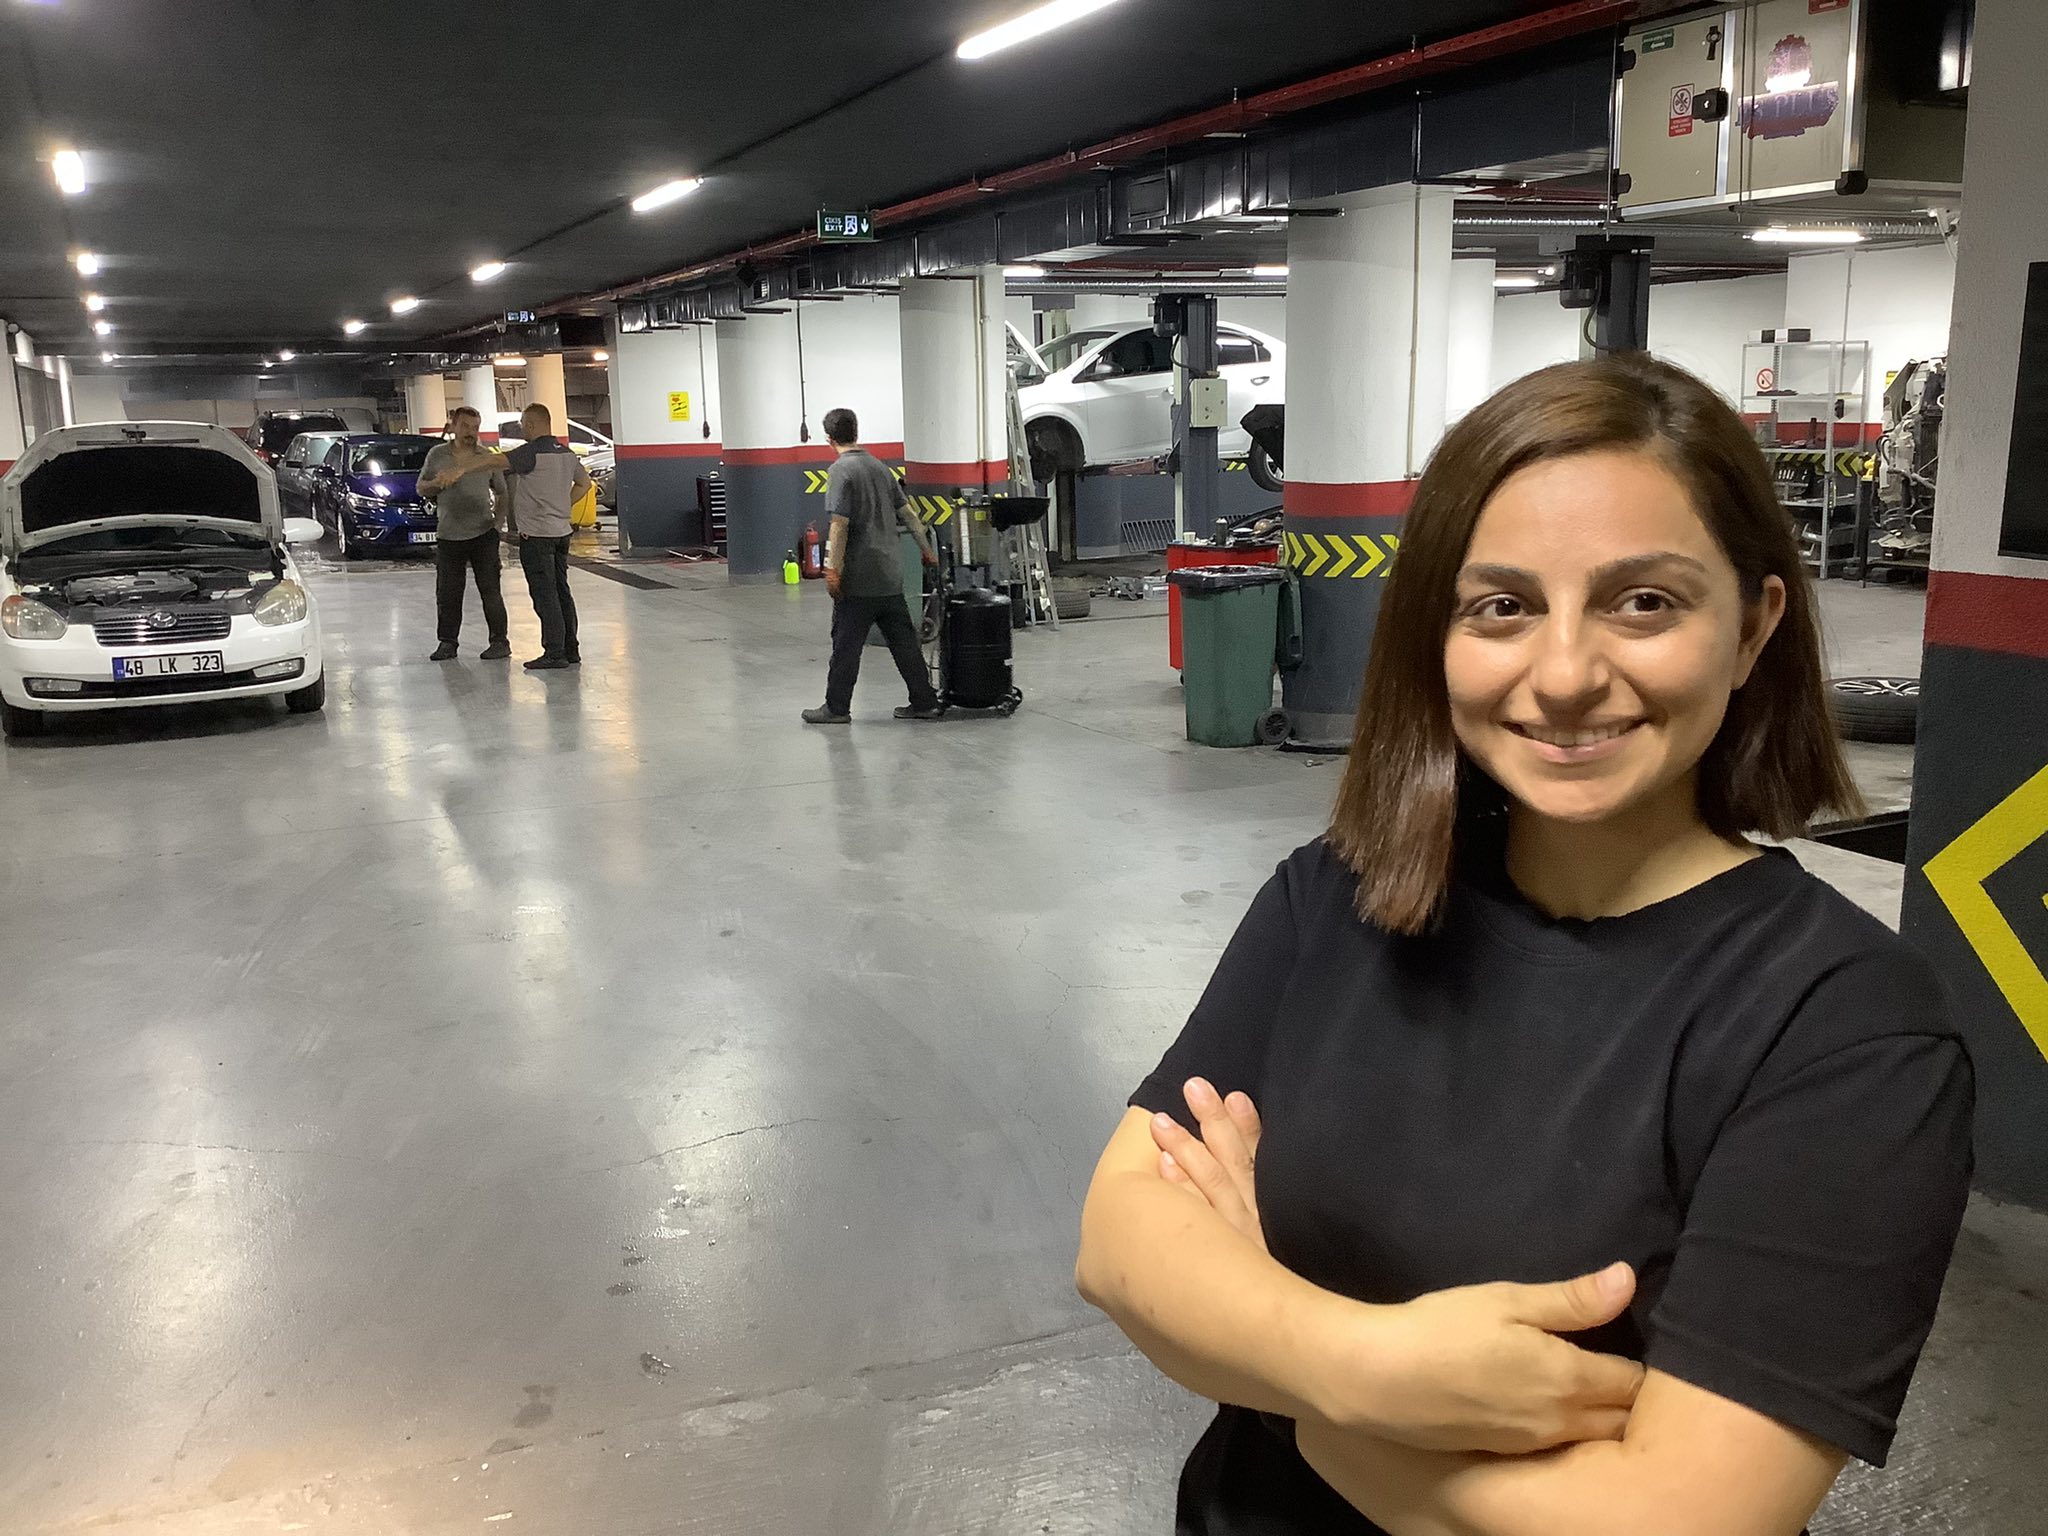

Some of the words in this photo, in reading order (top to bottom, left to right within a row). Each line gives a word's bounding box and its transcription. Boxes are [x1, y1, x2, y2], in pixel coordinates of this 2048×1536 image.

[125, 660, 143, 675] 48
[159, 657, 178, 673] LK
[192, 655, 220, 671] 323
